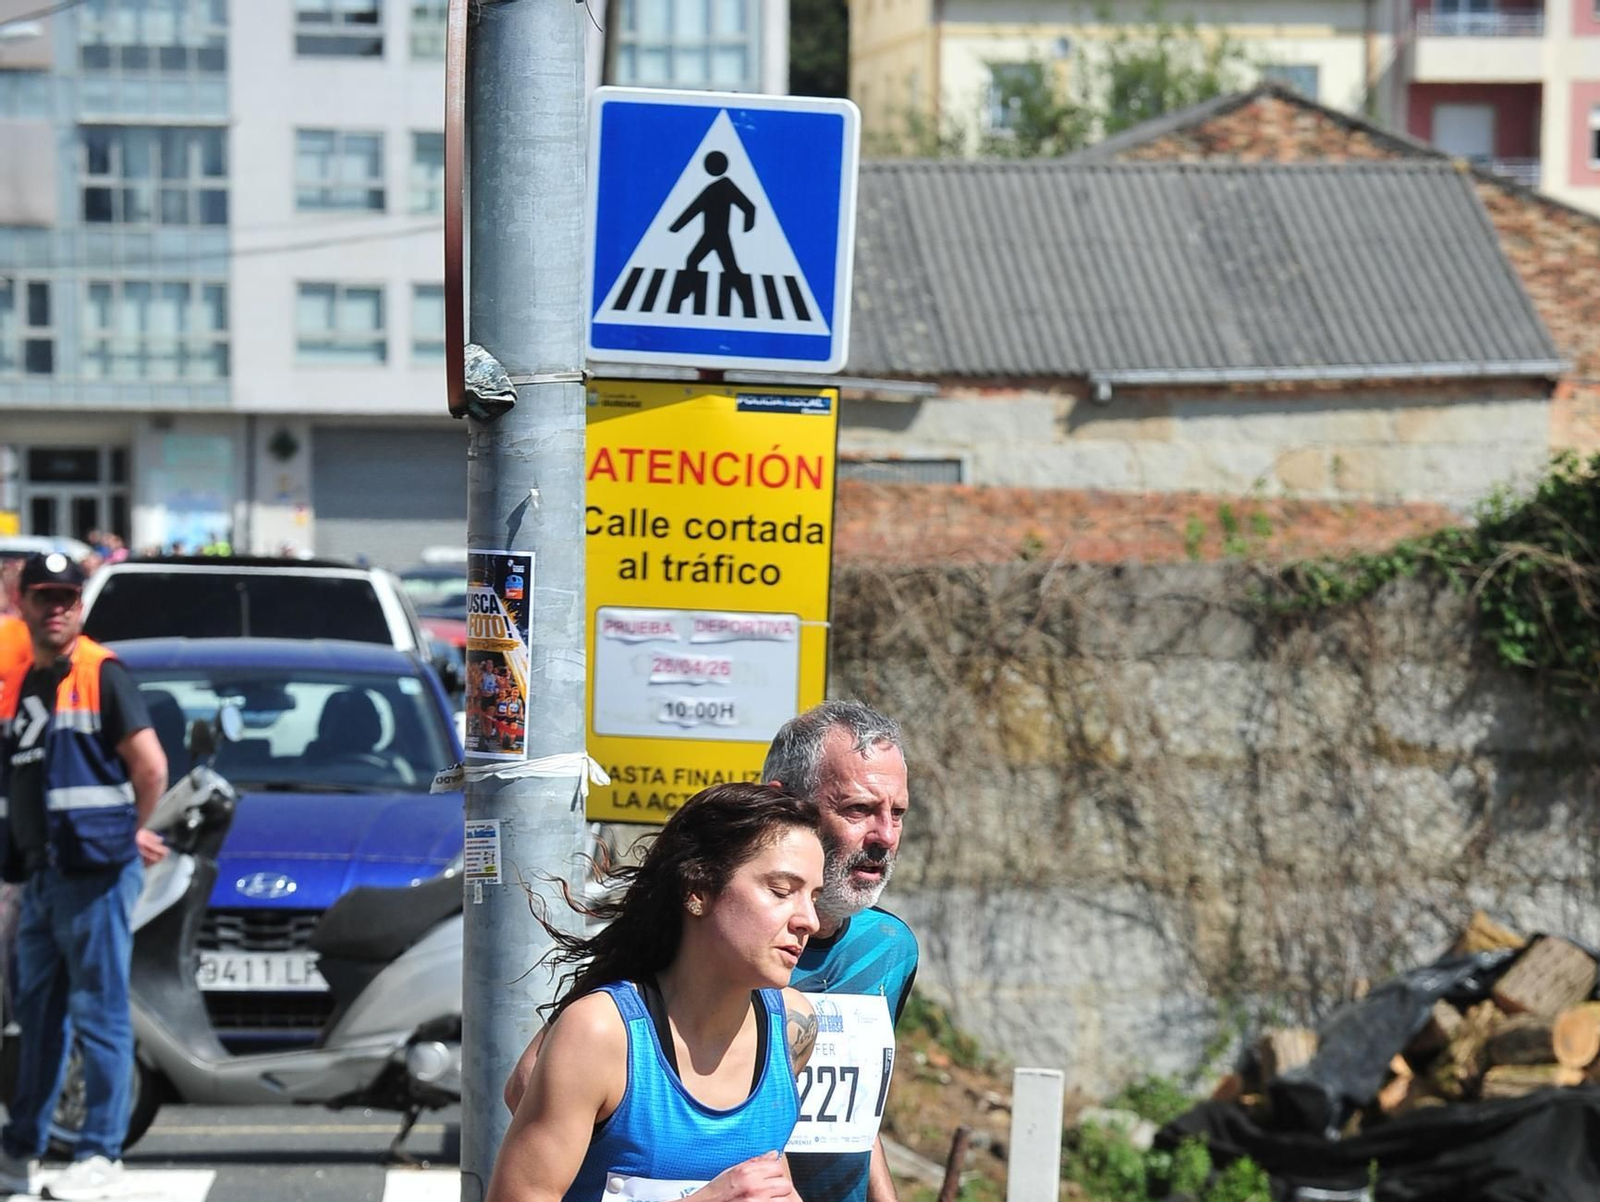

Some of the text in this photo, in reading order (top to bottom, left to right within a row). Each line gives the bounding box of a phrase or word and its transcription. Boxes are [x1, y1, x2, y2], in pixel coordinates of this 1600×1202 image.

[588, 444, 823, 490] ATENCIÓN
[586, 505, 825, 544] Calle cortada
[618, 551, 781, 586] al tráfico
[603, 618, 794, 635] PRUEBA DEPORTIVA
[664, 701, 734, 719] 10:00H
[601, 764, 666, 785] ASTA
[612, 791, 641, 809] LA
[815, 1043, 836, 1056] FER
[796, 1066, 859, 1122] 227
